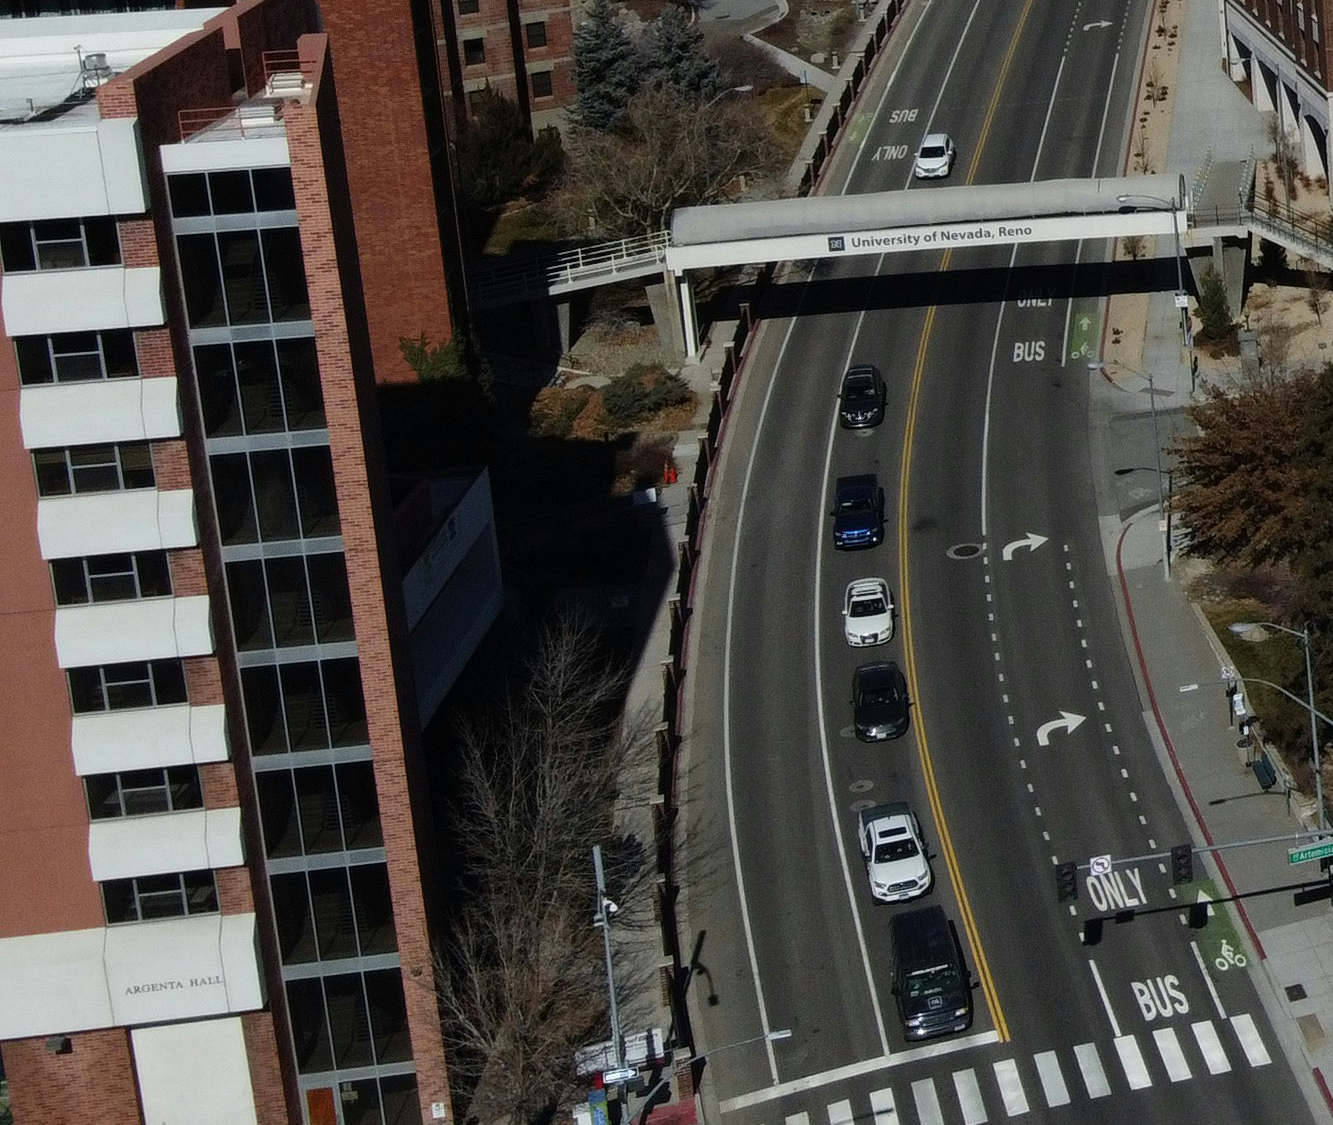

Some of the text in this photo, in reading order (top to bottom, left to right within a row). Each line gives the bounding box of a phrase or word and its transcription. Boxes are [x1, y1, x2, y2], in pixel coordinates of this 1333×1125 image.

[889, 108, 919, 124] BUS
[871, 145, 908, 161] ONLY
[851, 231, 920, 248] University
[923, 229, 939, 243] of
[940, 227, 995, 241] Nevada,
[998, 226, 1032, 237] Reno
[1013, 341, 1046, 362] BUS
[1086, 868, 1147, 912] ONLY
[124, 975, 223, 995] ARGENTA HALL
[1131, 975, 1190, 1021] BUS
